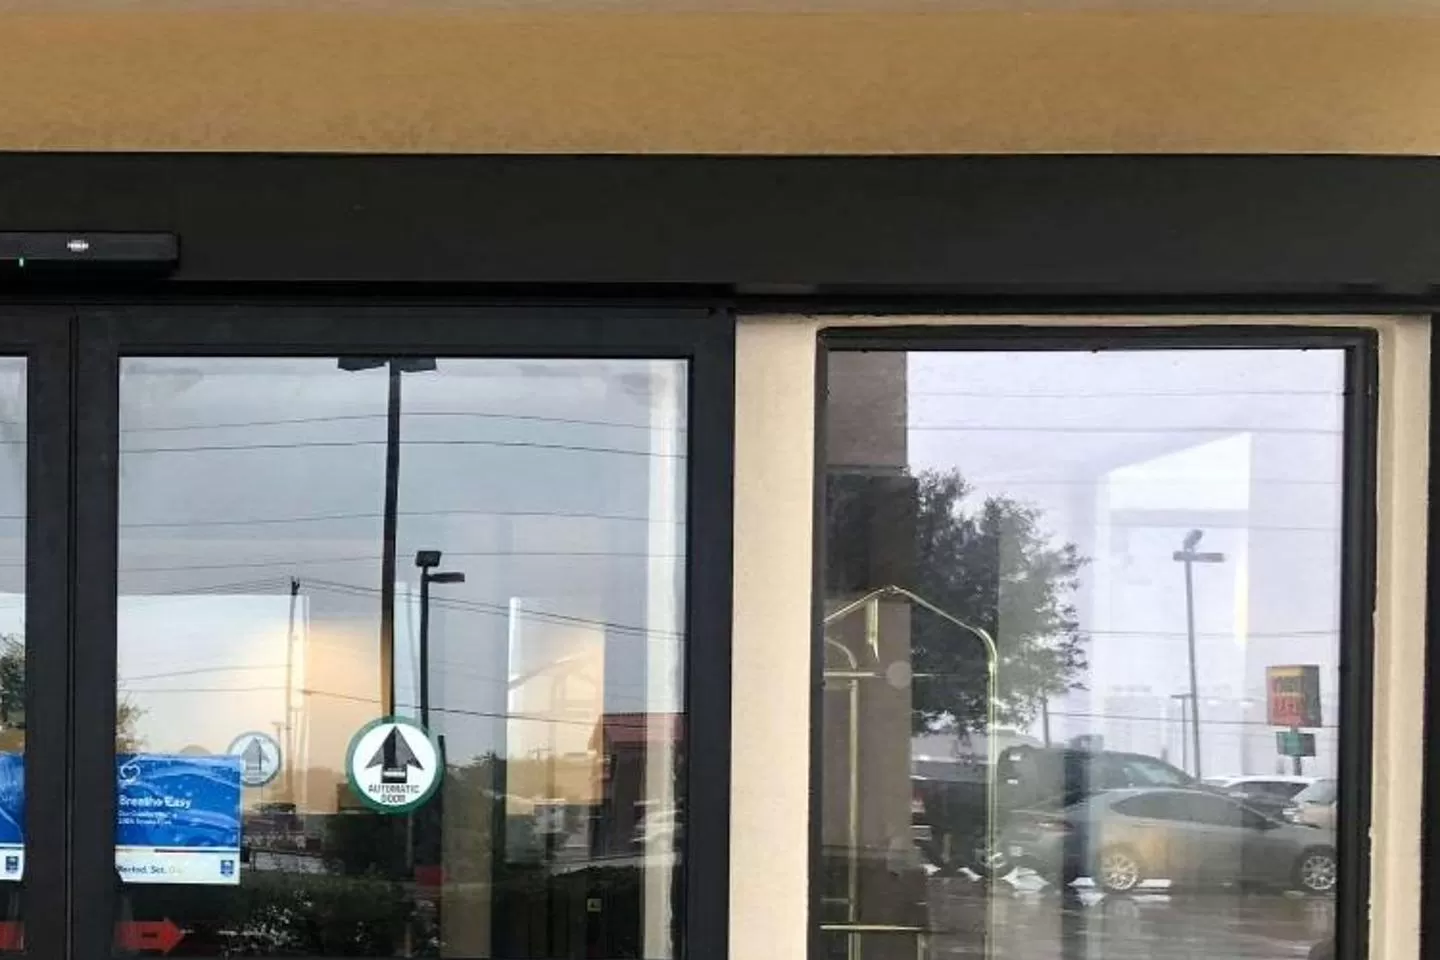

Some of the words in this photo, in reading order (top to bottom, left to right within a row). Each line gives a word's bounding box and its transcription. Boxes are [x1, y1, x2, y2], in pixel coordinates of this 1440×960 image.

[368, 784, 420, 794] AUTOMATIC
[118, 795, 163, 807] Breathe
[164, 795, 192, 809] Easy
[380, 794, 406, 803] DOOR
